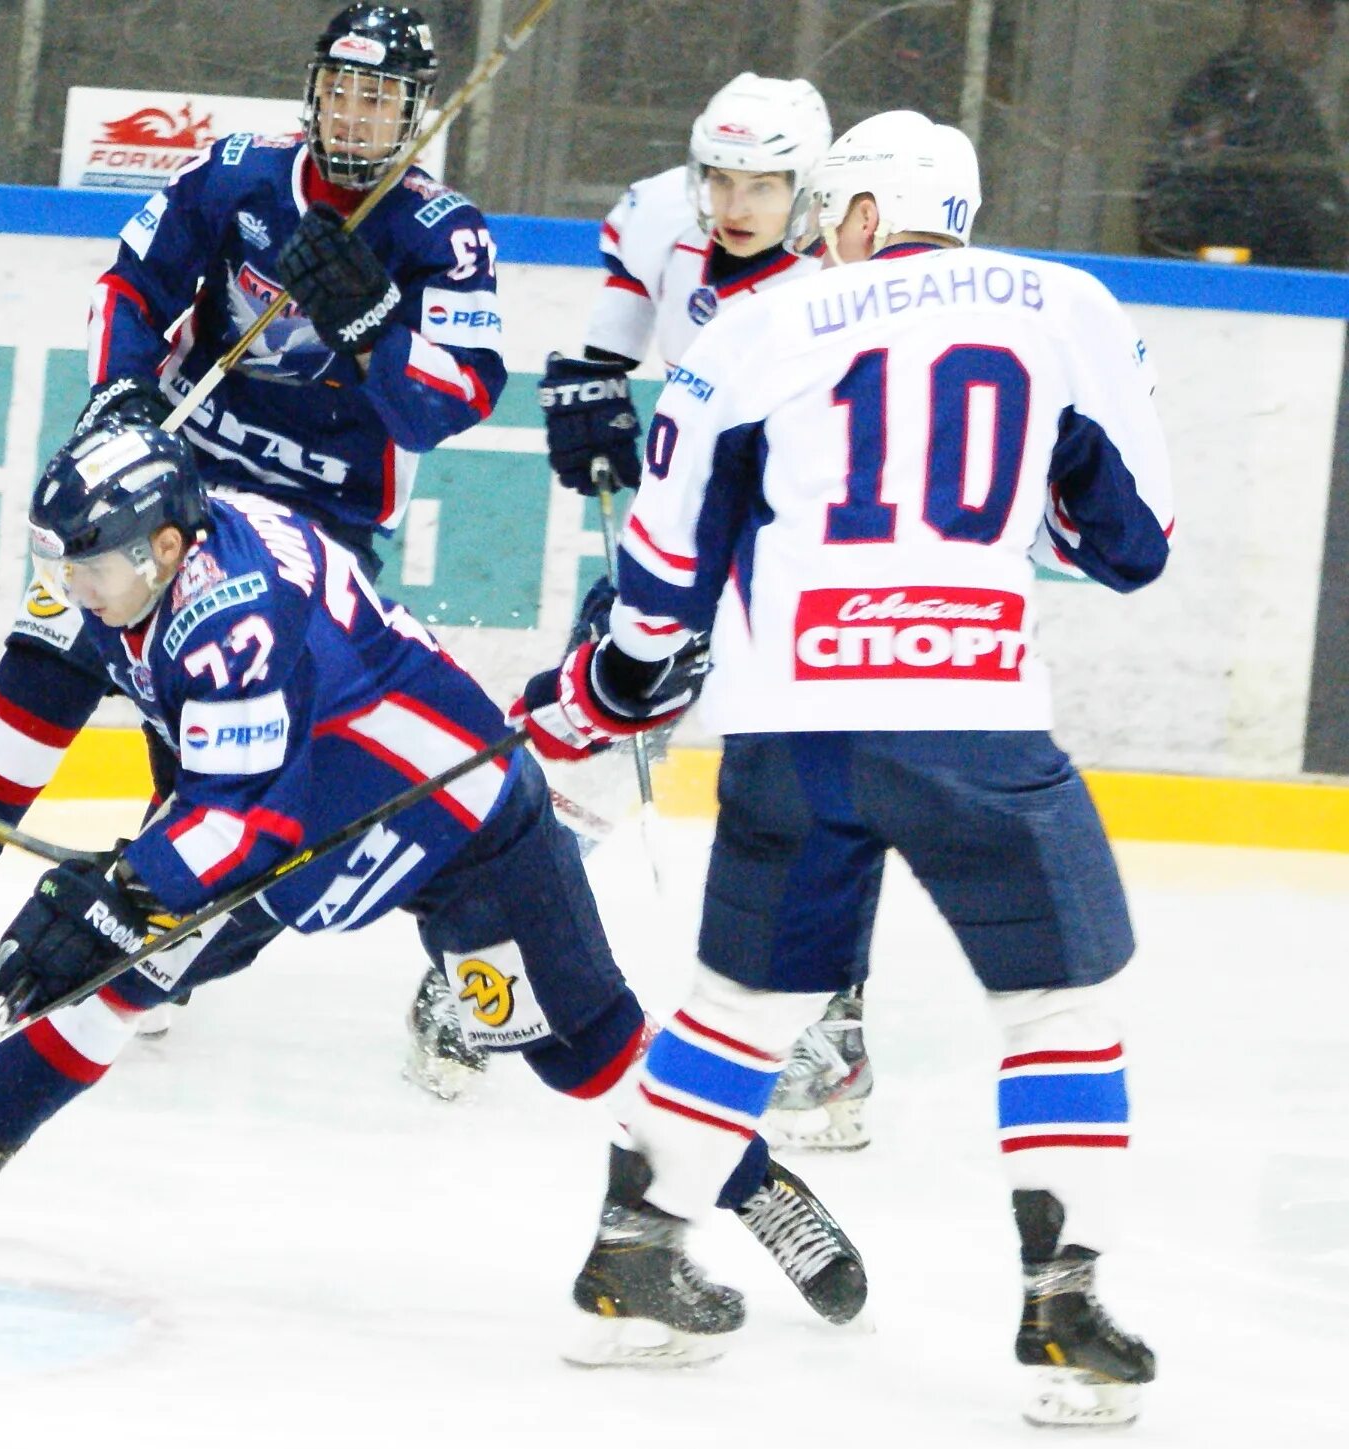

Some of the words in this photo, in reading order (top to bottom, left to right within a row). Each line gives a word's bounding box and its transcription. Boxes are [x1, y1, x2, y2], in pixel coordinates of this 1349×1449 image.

[87, 149, 198, 171] FORW
[942, 195, 968, 234] 10
[448, 228, 498, 281] 67
[453, 309, 502, 333] PEP
[807, 266, 1044, 337] ШИБАНОВ
[75, 377, 138, 436] eebok
[540, 377, 629, 407] STON
[647, 412, 679, 481] 0
[822, 342, 1032, 546] 10
[837, 592, 1004, 621] Советский
[183, 615, 276, 690] 72
[796, 624, 1031, 670] СПОРТ
[295, 821, 401, 928] АЗ
[83, 899, 146, 955] Reebo
